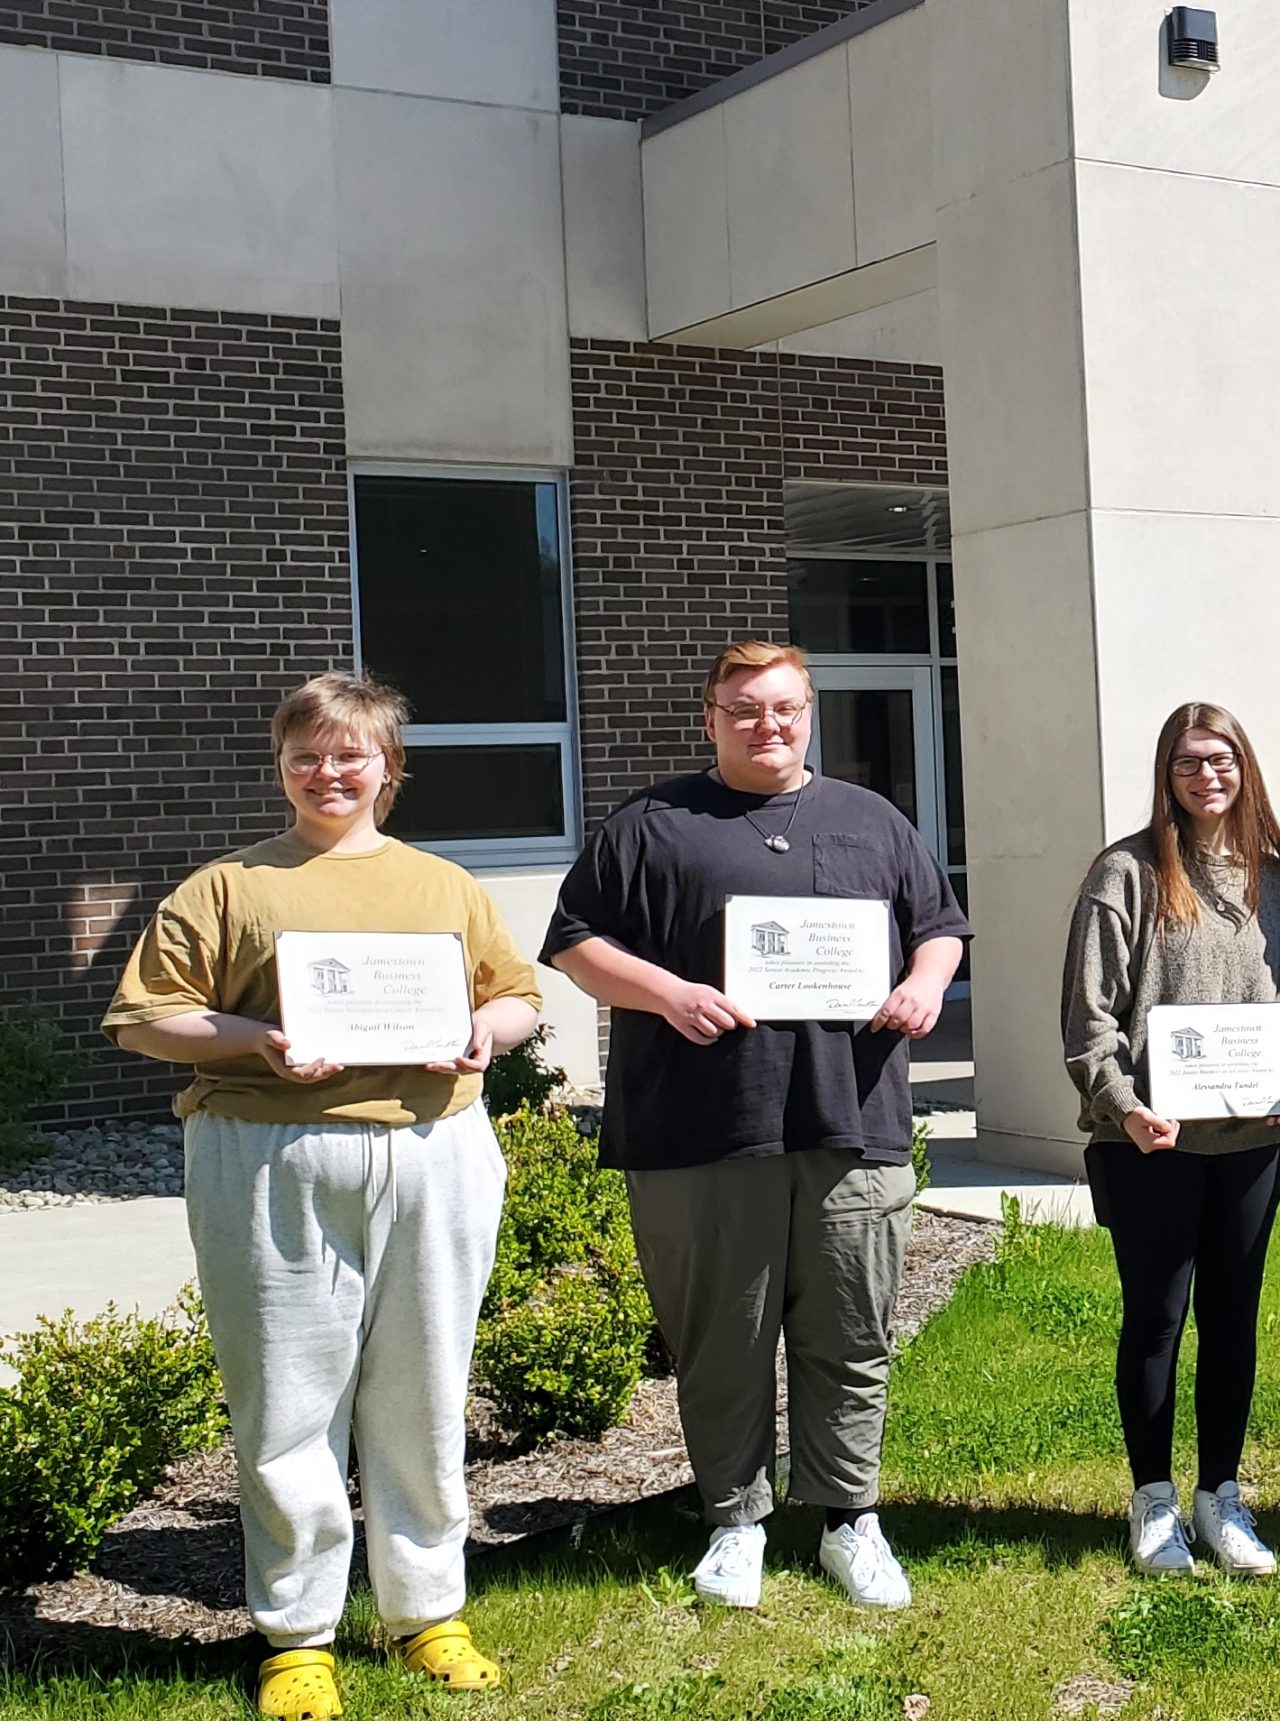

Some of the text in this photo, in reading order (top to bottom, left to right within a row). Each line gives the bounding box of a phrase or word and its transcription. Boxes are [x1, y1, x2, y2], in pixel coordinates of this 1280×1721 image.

[799, 919, 856, 930] Jamestown
[808, 933, 852, 943] Business
[815, 946, 855, 958] College
[361, 956, 425, 966] Jamestown
[373, 970, 422, 980] Business
[383, 984, 426, 996] College
[768, 981, 796, 990] Carter
[348, 1022, 415, 1032] Abigail Wilson
[1213, 1024, 1262, 1033] Jamestown
[1221, 1036, 1259, 1045] Business
[1228, 1048, 1262, 1058] College
[1192, 1082, 1232, 1091] Alessandra
